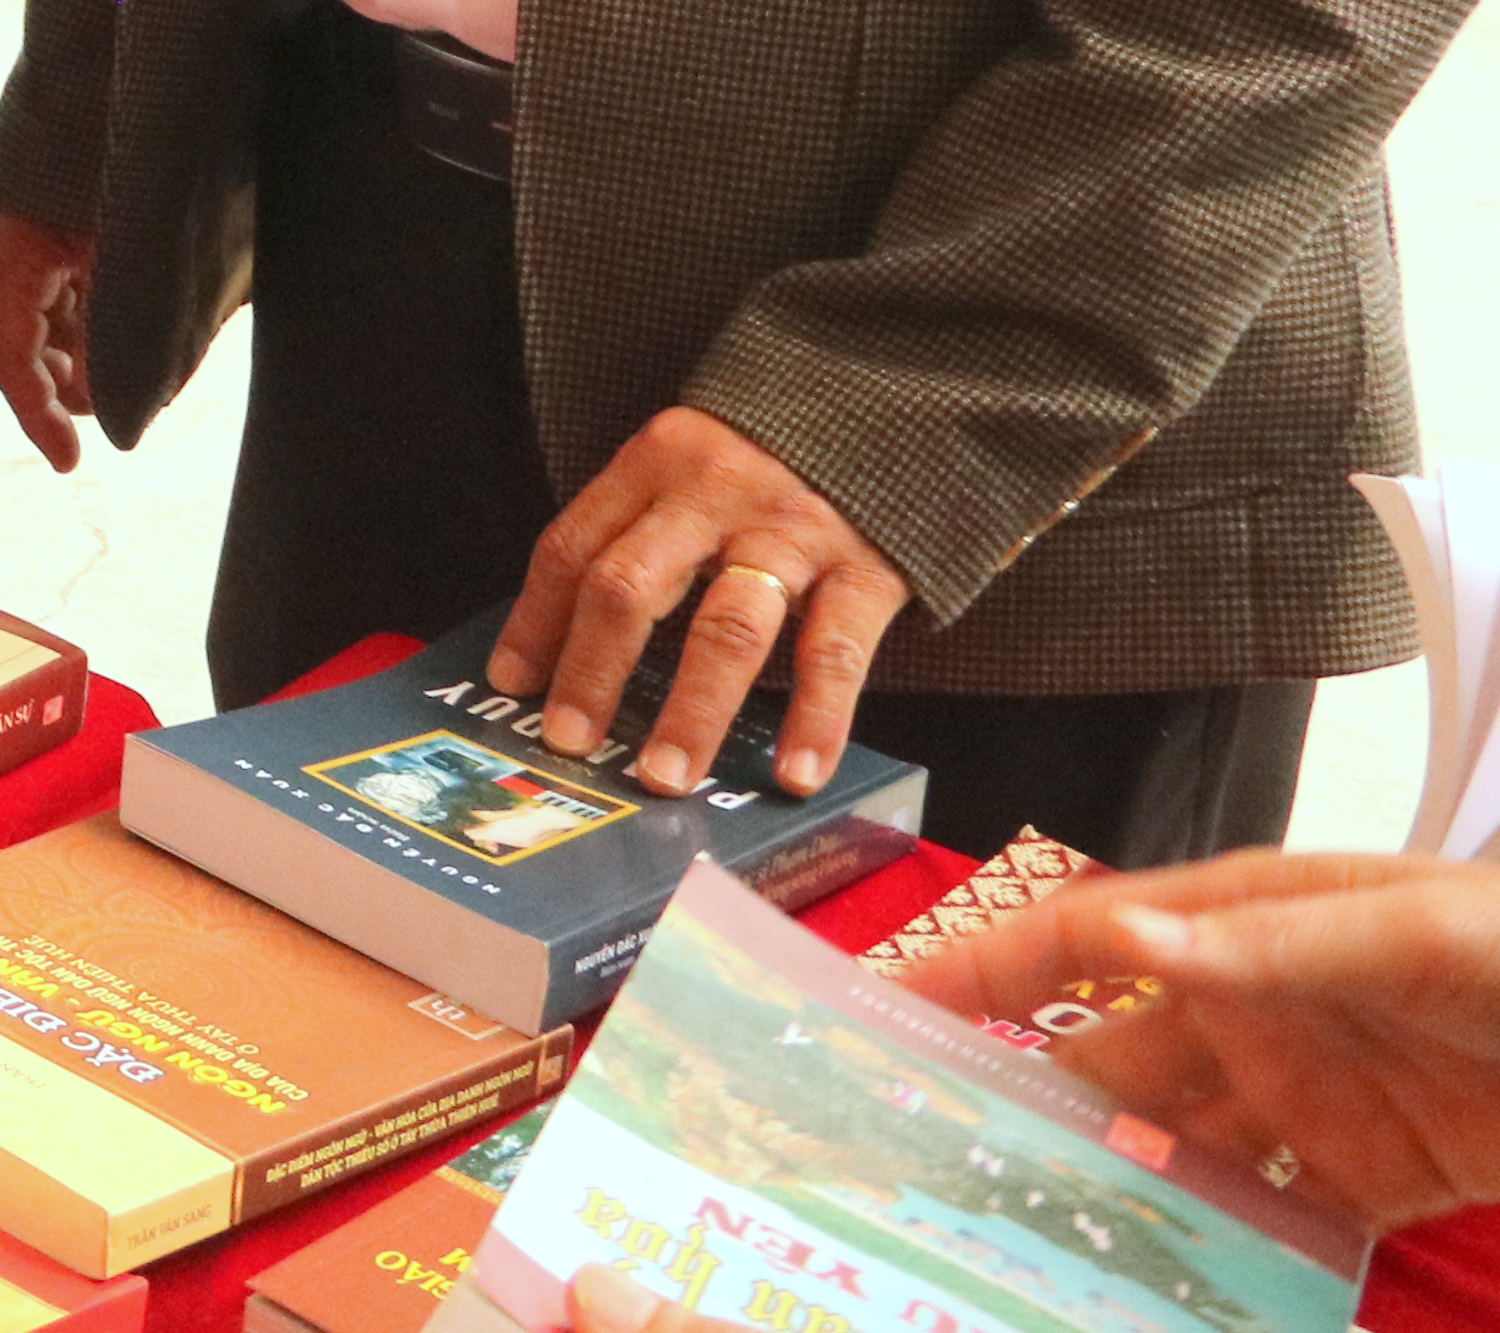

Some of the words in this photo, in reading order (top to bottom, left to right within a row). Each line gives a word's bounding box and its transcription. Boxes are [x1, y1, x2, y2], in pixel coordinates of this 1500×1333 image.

[41, 963, 93, 991] DÂN
[66, 958, 136, 995] THIÊN
[127, 1006, 184, 1040] NGÔN
[135, 991, 198, 1027] THỪA
[73, 1007, 169, 1054] NGỮ
[195, 1024, 239, 1048] TÂY
[60, 1031, 164, 1084] ĐẶC
[176, 1035, 236, 1068] DANH
[232, 1057, 270, 1081] ĐỊA
[165, 1050, 288, 1114] NGÔN
[269, 1073, 309, 1101] CỦA
[688, 1195, 868, 1301] YÊN
